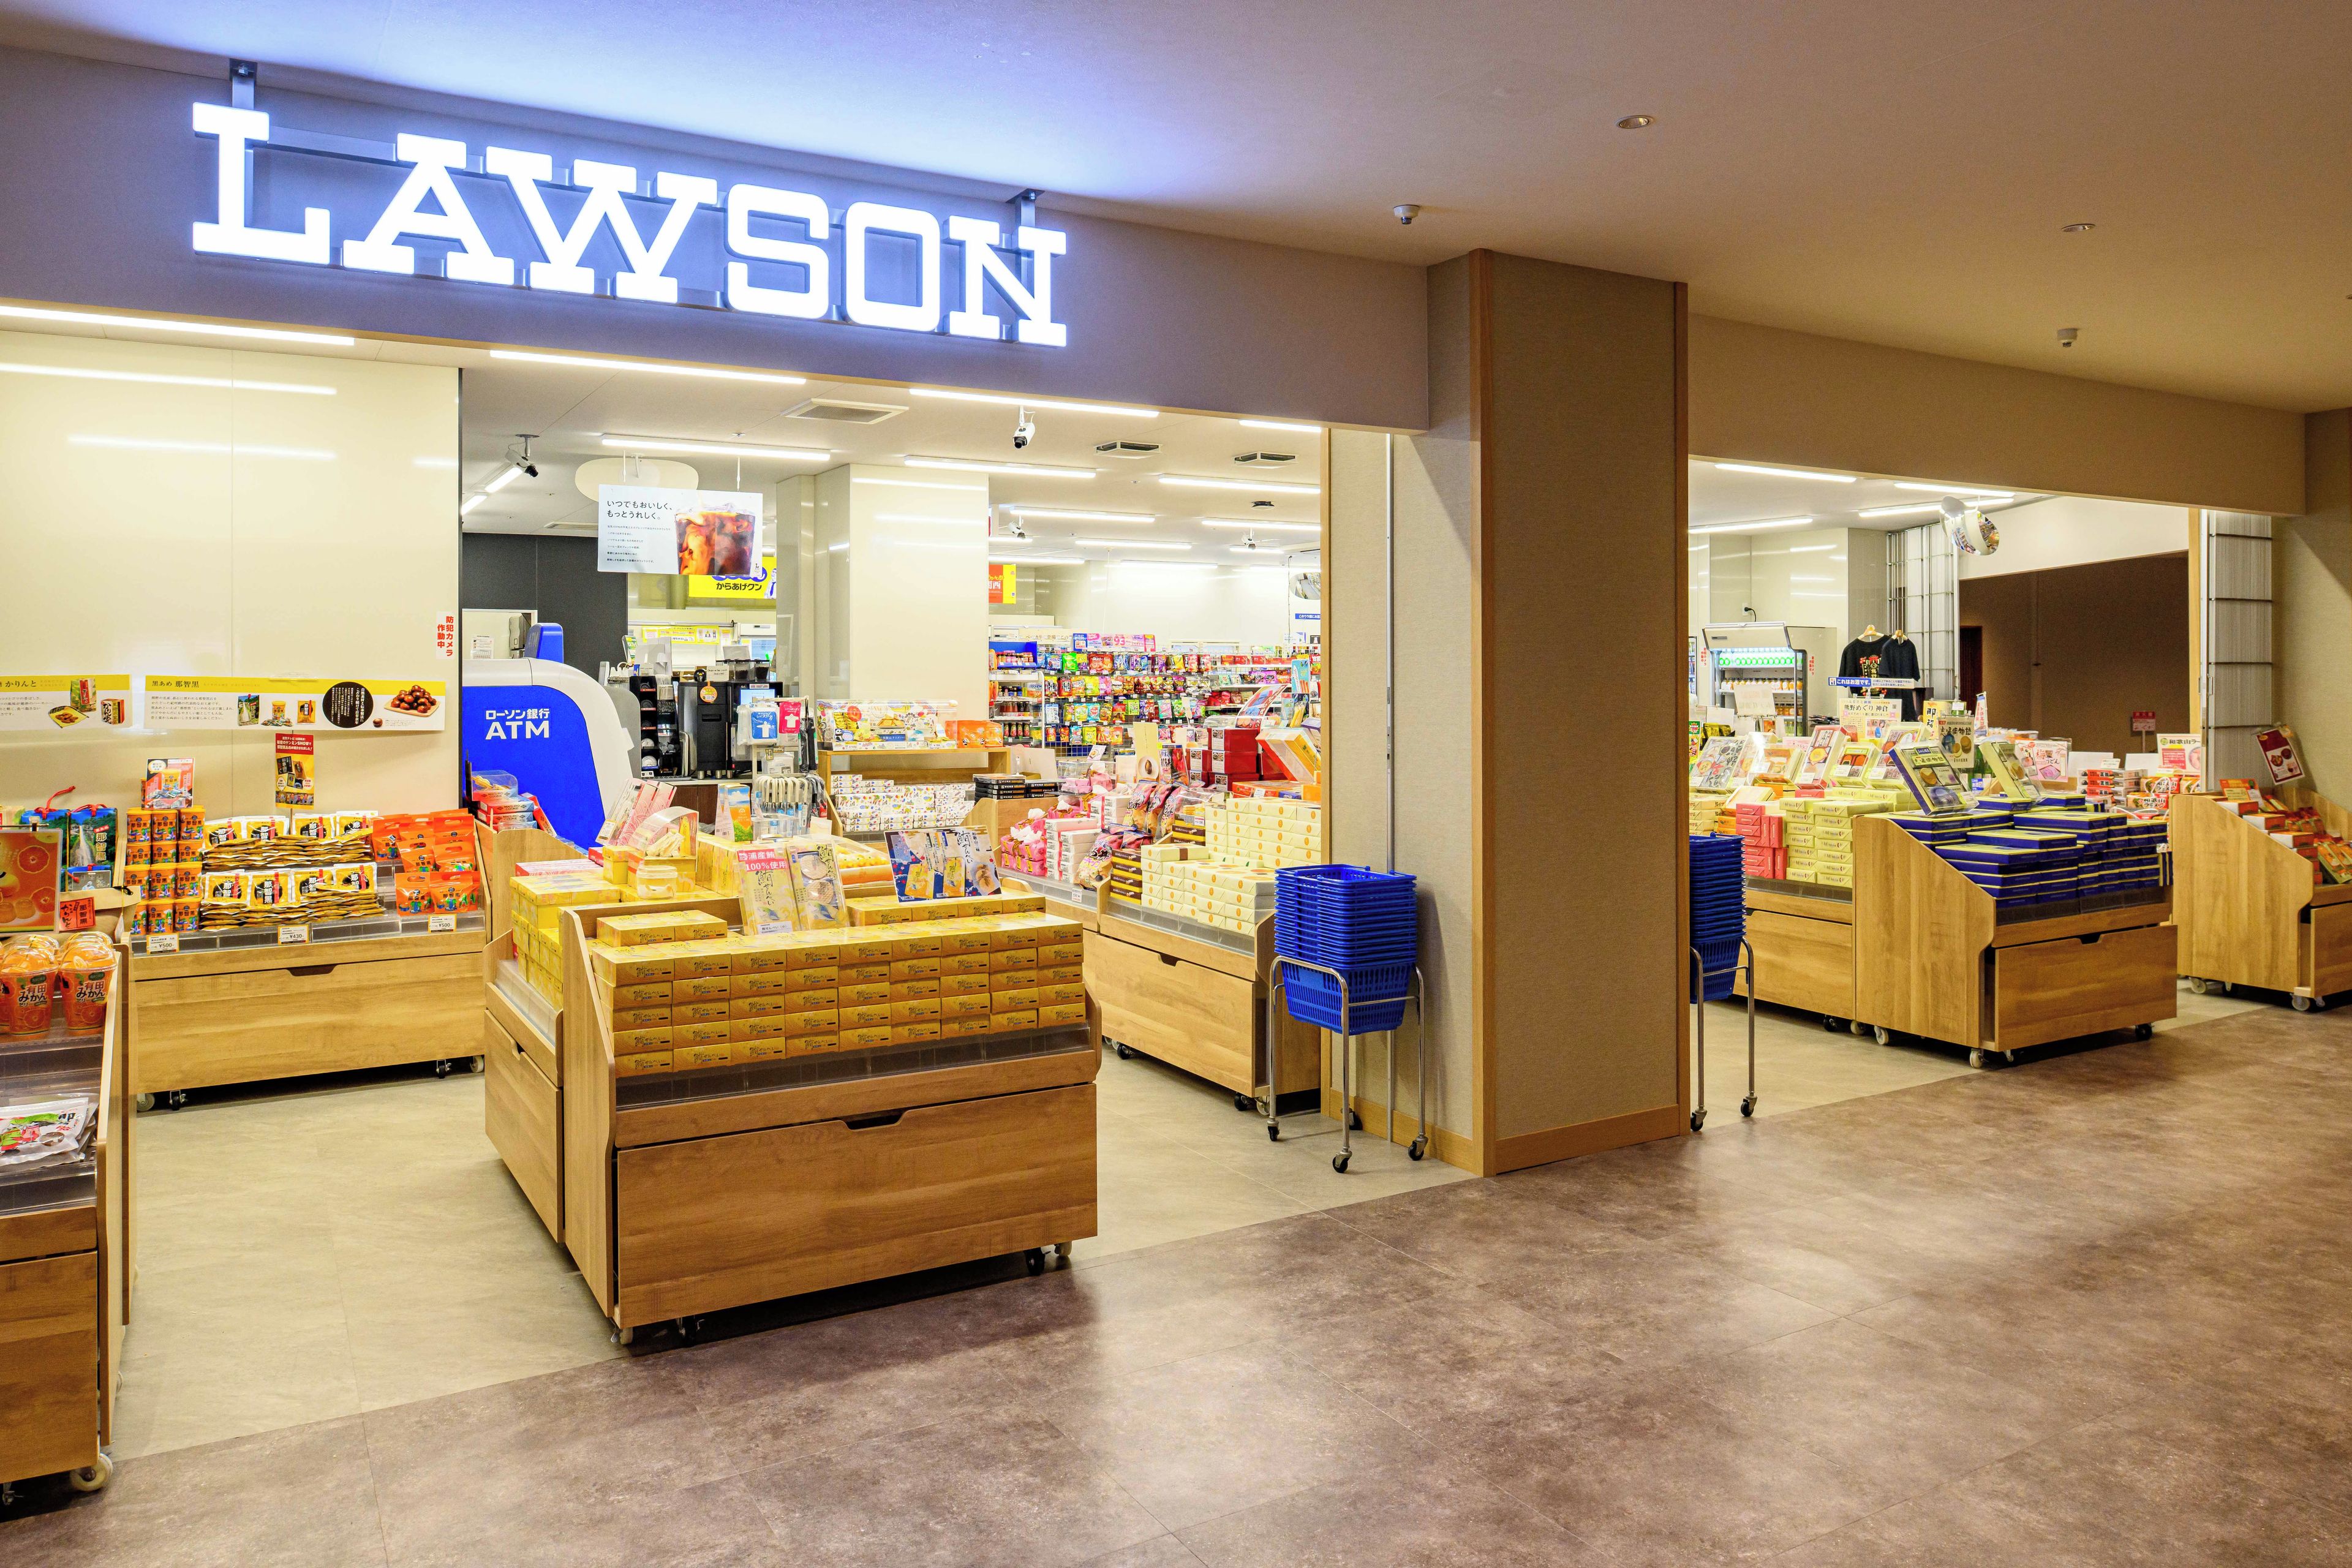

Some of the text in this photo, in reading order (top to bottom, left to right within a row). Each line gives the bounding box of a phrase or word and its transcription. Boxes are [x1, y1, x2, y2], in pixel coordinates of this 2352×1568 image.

[193, 101, 1067, 347] LAWSON
[607, 499, 673, 511] いつでもおいしく、
[607, 510, 661, 520] もっとうれしく。
[716, 582, 762, 591] からあげクン
[437, 624, 445, 649] 作動中
[486, 709, 549, 720] ローソン銀行
[485, 720, 549, 739] ATM
[96, 832, 107, 861] 那智黒
[745, 861, 788, 871] 100%使用
[27, 984, 47, 994] 有田
[85, 981, 104, 991] 有田
[18, 991, 47, 1002] みかん
[77, 989, 105, 998] みかん
